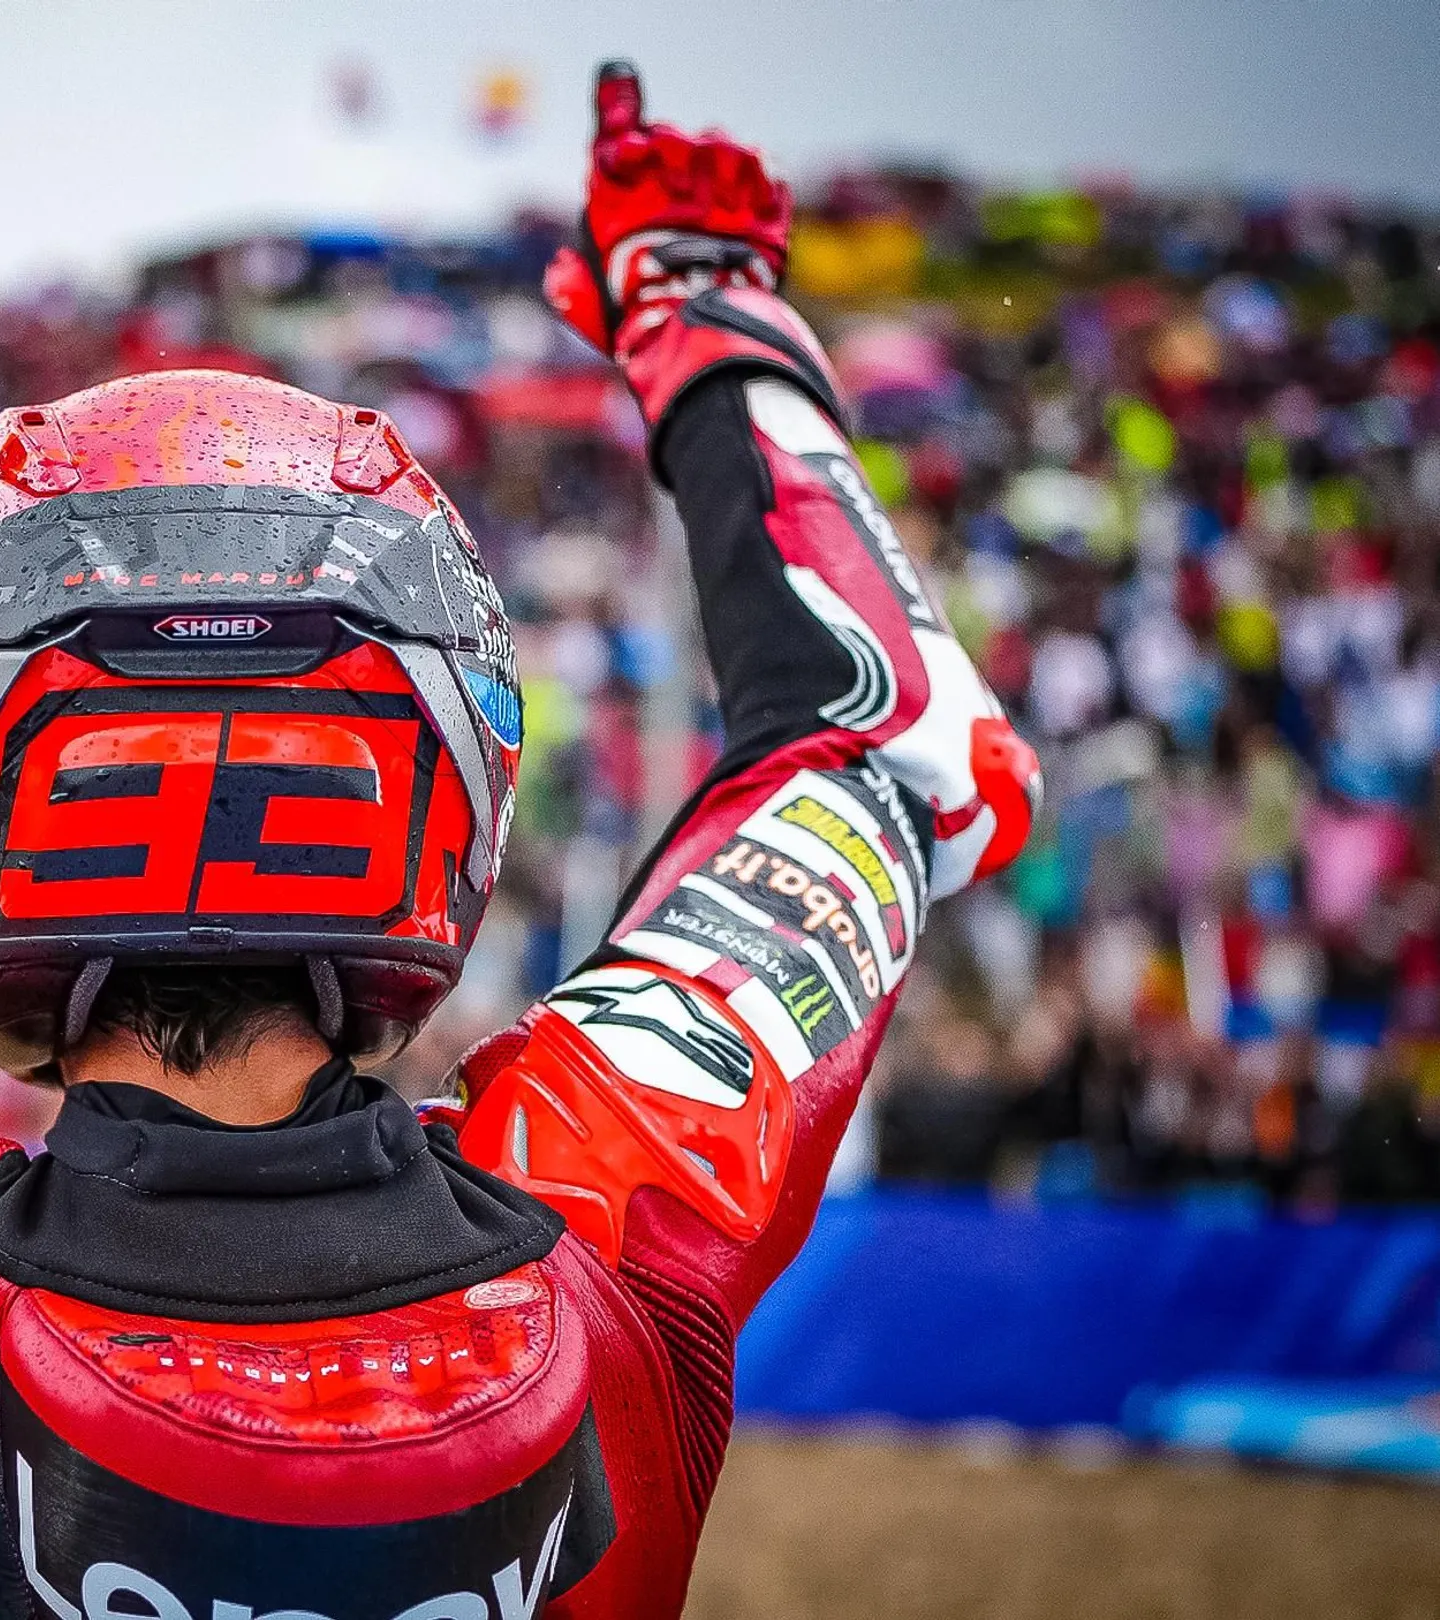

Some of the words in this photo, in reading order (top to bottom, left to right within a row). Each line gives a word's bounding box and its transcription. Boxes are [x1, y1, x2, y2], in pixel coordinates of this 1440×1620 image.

[63, 566, 158, 587] MARC
[180, 565, 358, 587] MARQUE
[172, 618, 255, 637] SHOEI
[714, 842, 881, 999] aruba.it
